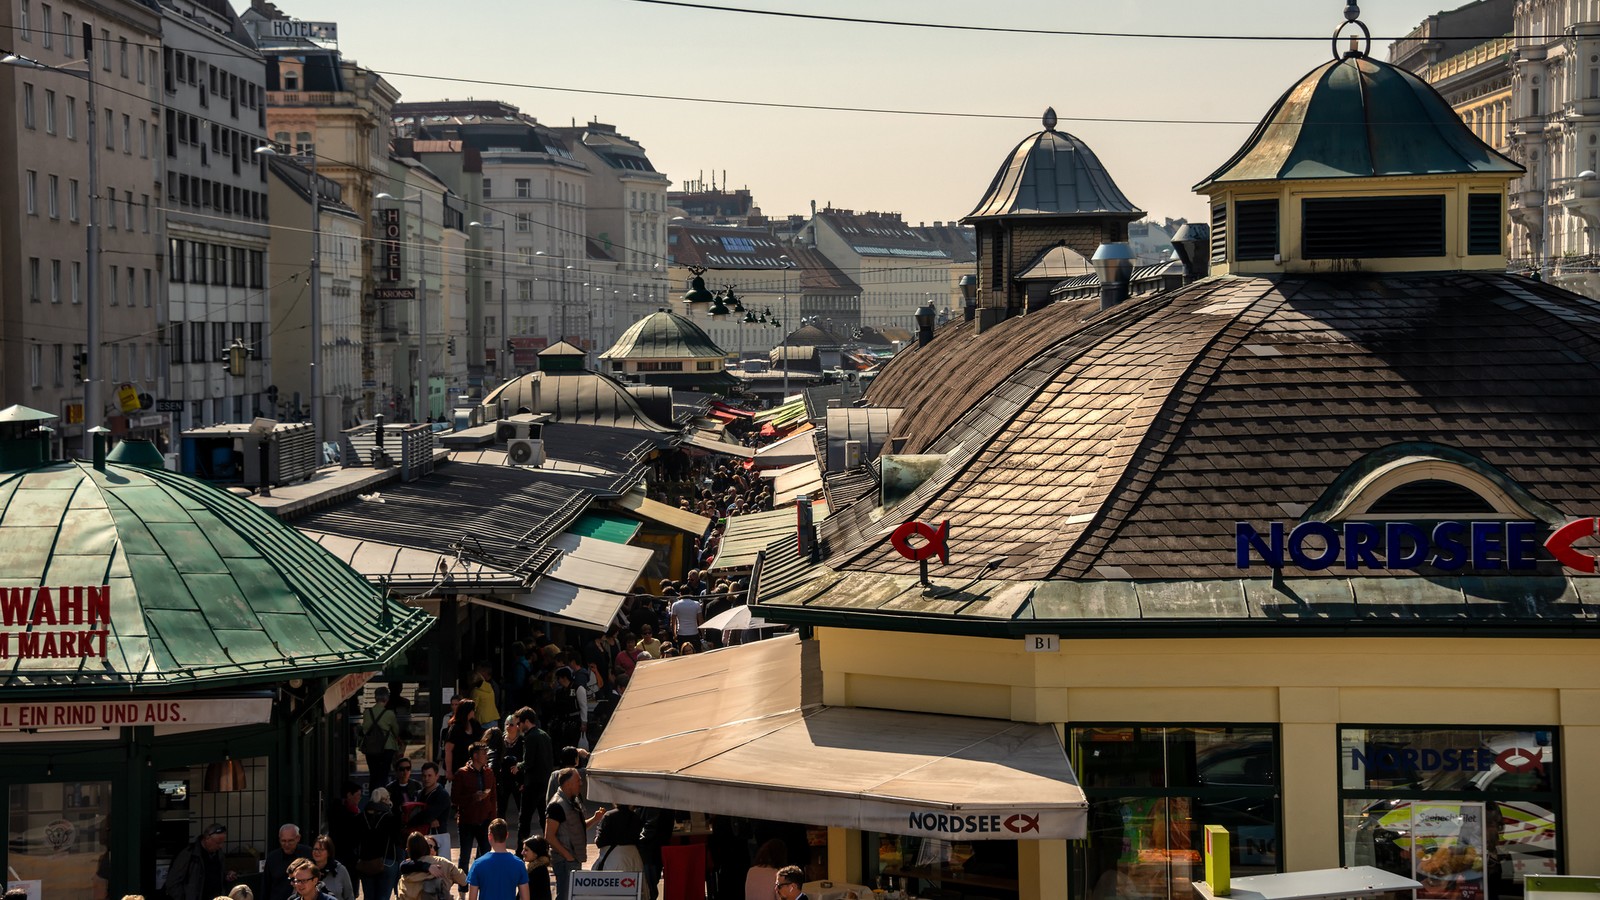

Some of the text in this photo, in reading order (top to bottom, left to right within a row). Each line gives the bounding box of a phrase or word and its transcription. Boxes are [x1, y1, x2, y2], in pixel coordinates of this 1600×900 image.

[273, 21, 316, 37] HOTEL
[388, 210, 399, 281] HOTEL
[383, 290, 413, 298] KRONEN
[1235, 520, 1538, 571] NORDSEE
[0, 585, 110, 626] WAHN
[18, 630, 110, 659] MARKT
[19, 706, 48, 726] EIN
[54, 705, 96, 725] RIND
[102, 704, 139, 724] UND
[144, 703, 187, 722] AUS.
[1352, 747, 1491, 772] NORDSEE
[909, 811, 1001, 833] NORDSEE
[575, 877, 619, 887] NORDSEE
